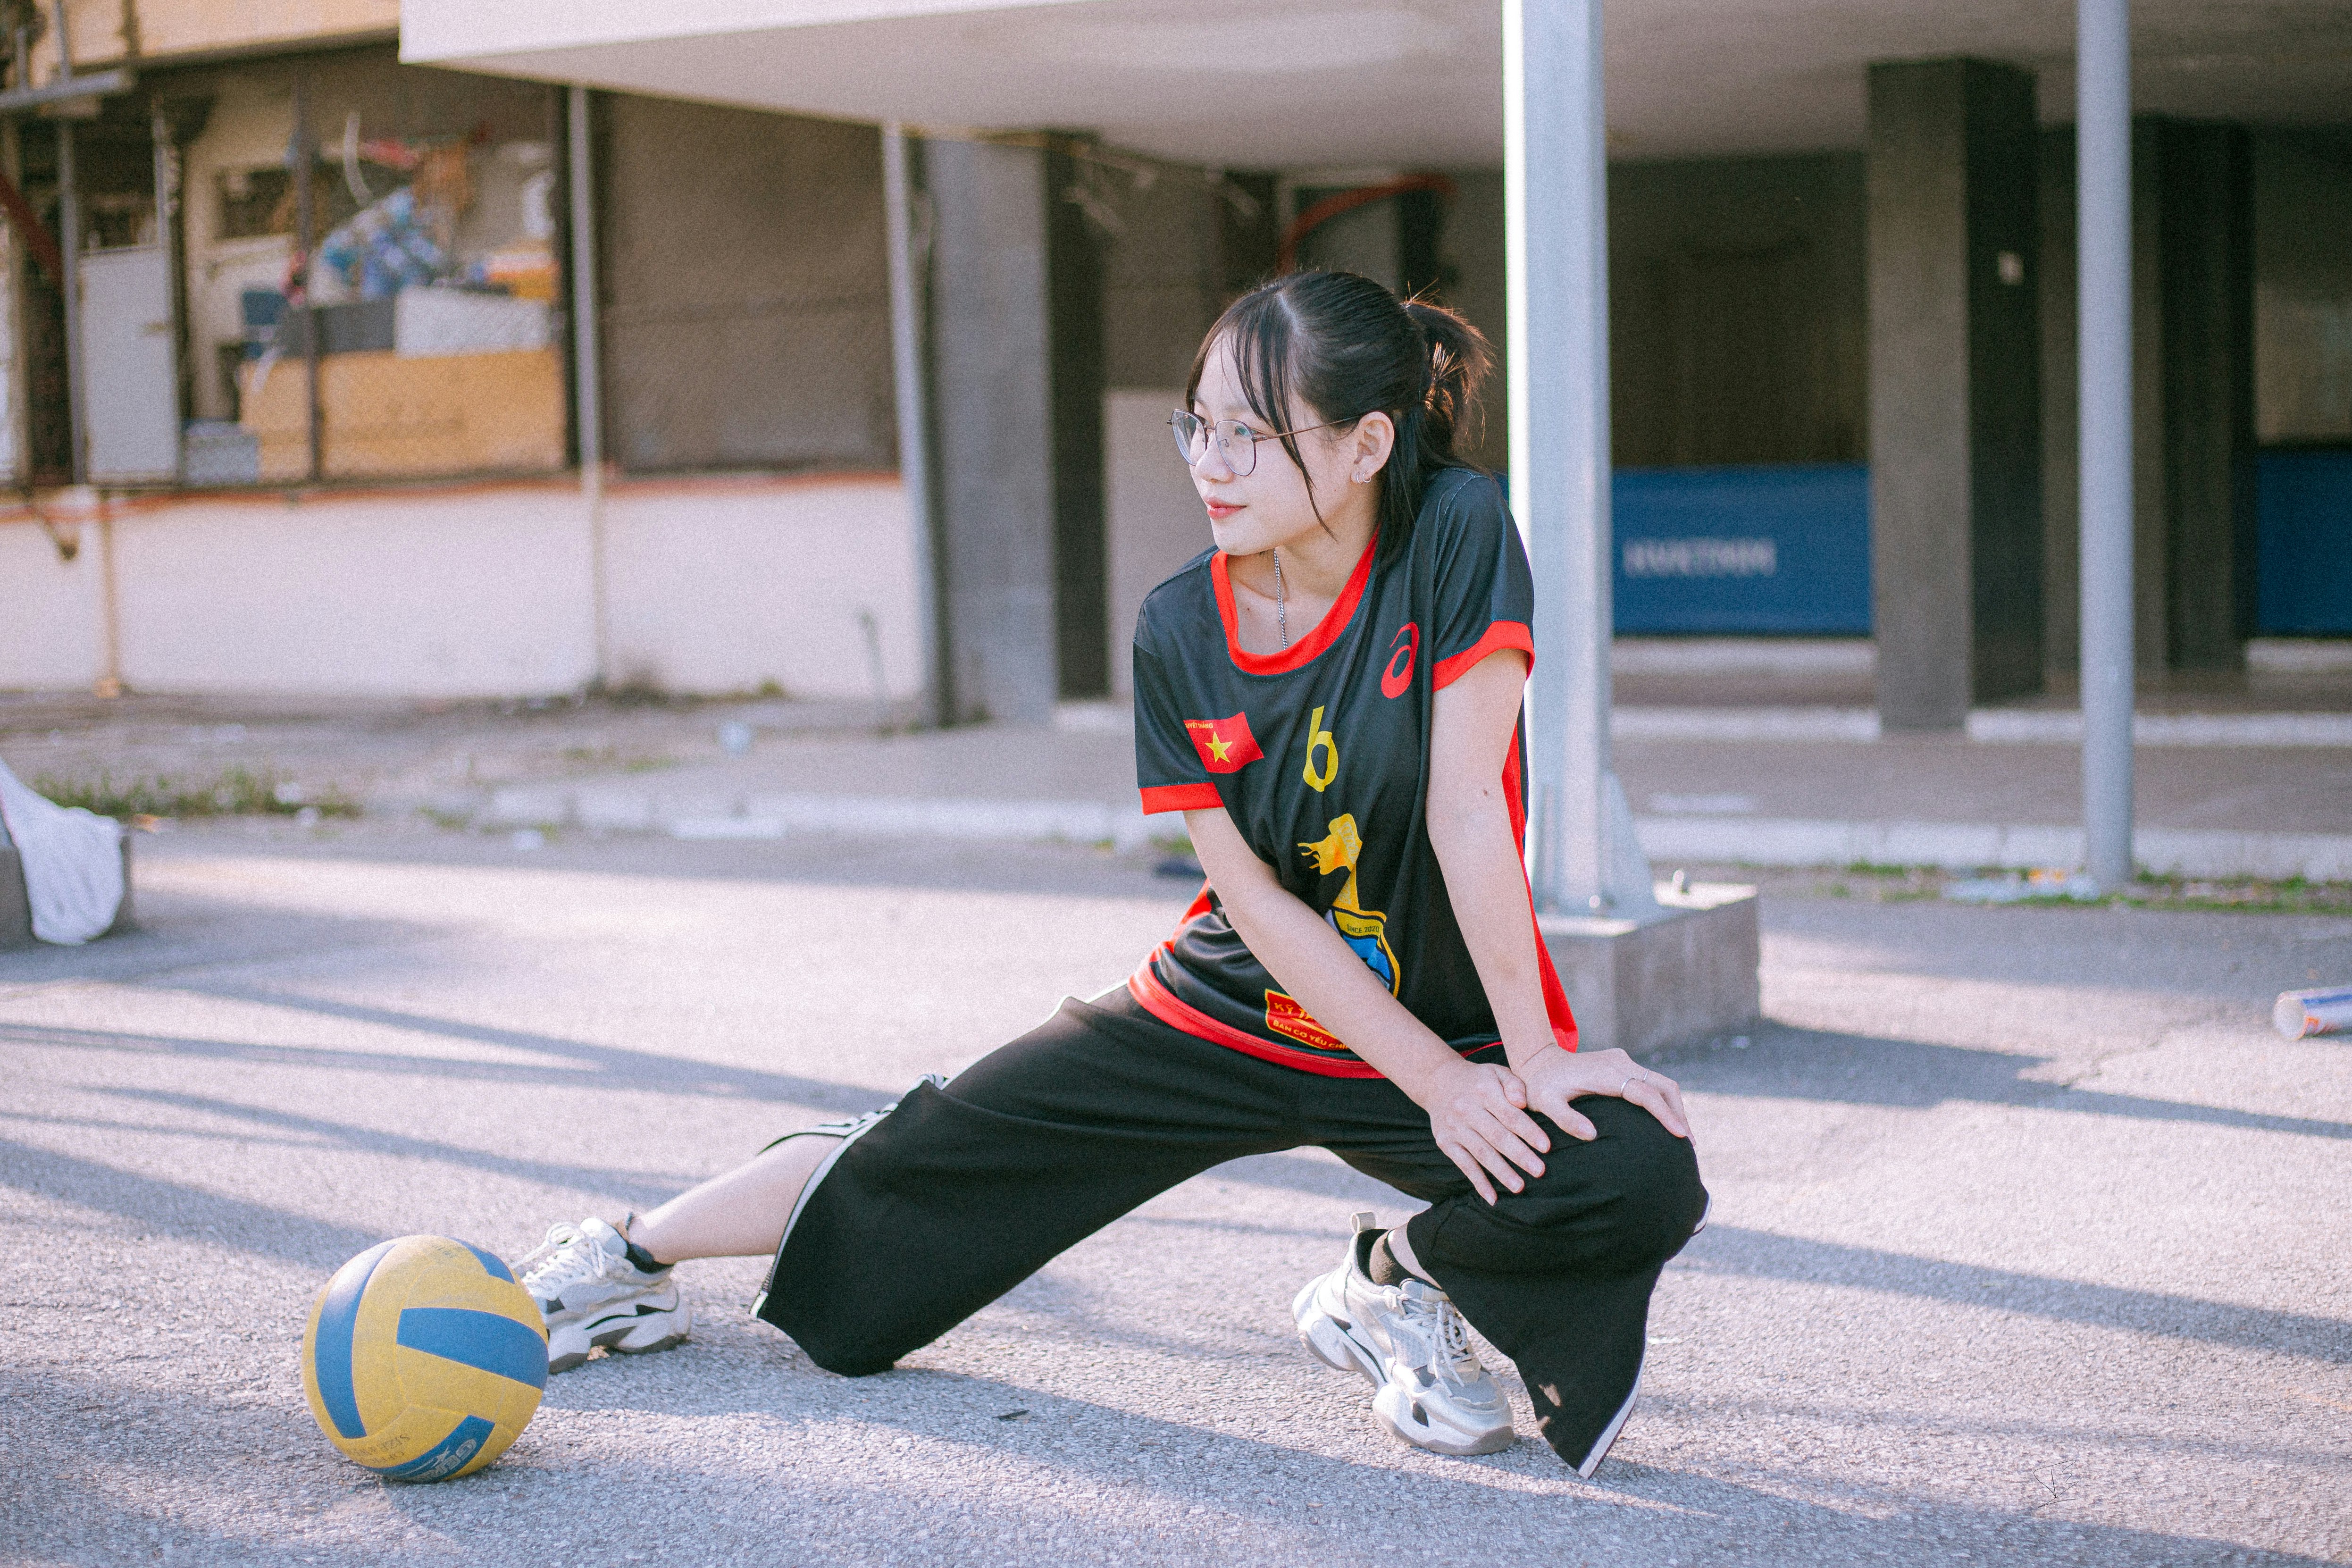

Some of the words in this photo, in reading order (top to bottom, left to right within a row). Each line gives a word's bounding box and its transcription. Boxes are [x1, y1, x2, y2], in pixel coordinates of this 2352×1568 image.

[1303, 705, 1339, 792] 6
[1347, 924, 1362, 933] SINCE
[1273, 1019, 1291, 1032] BAN
